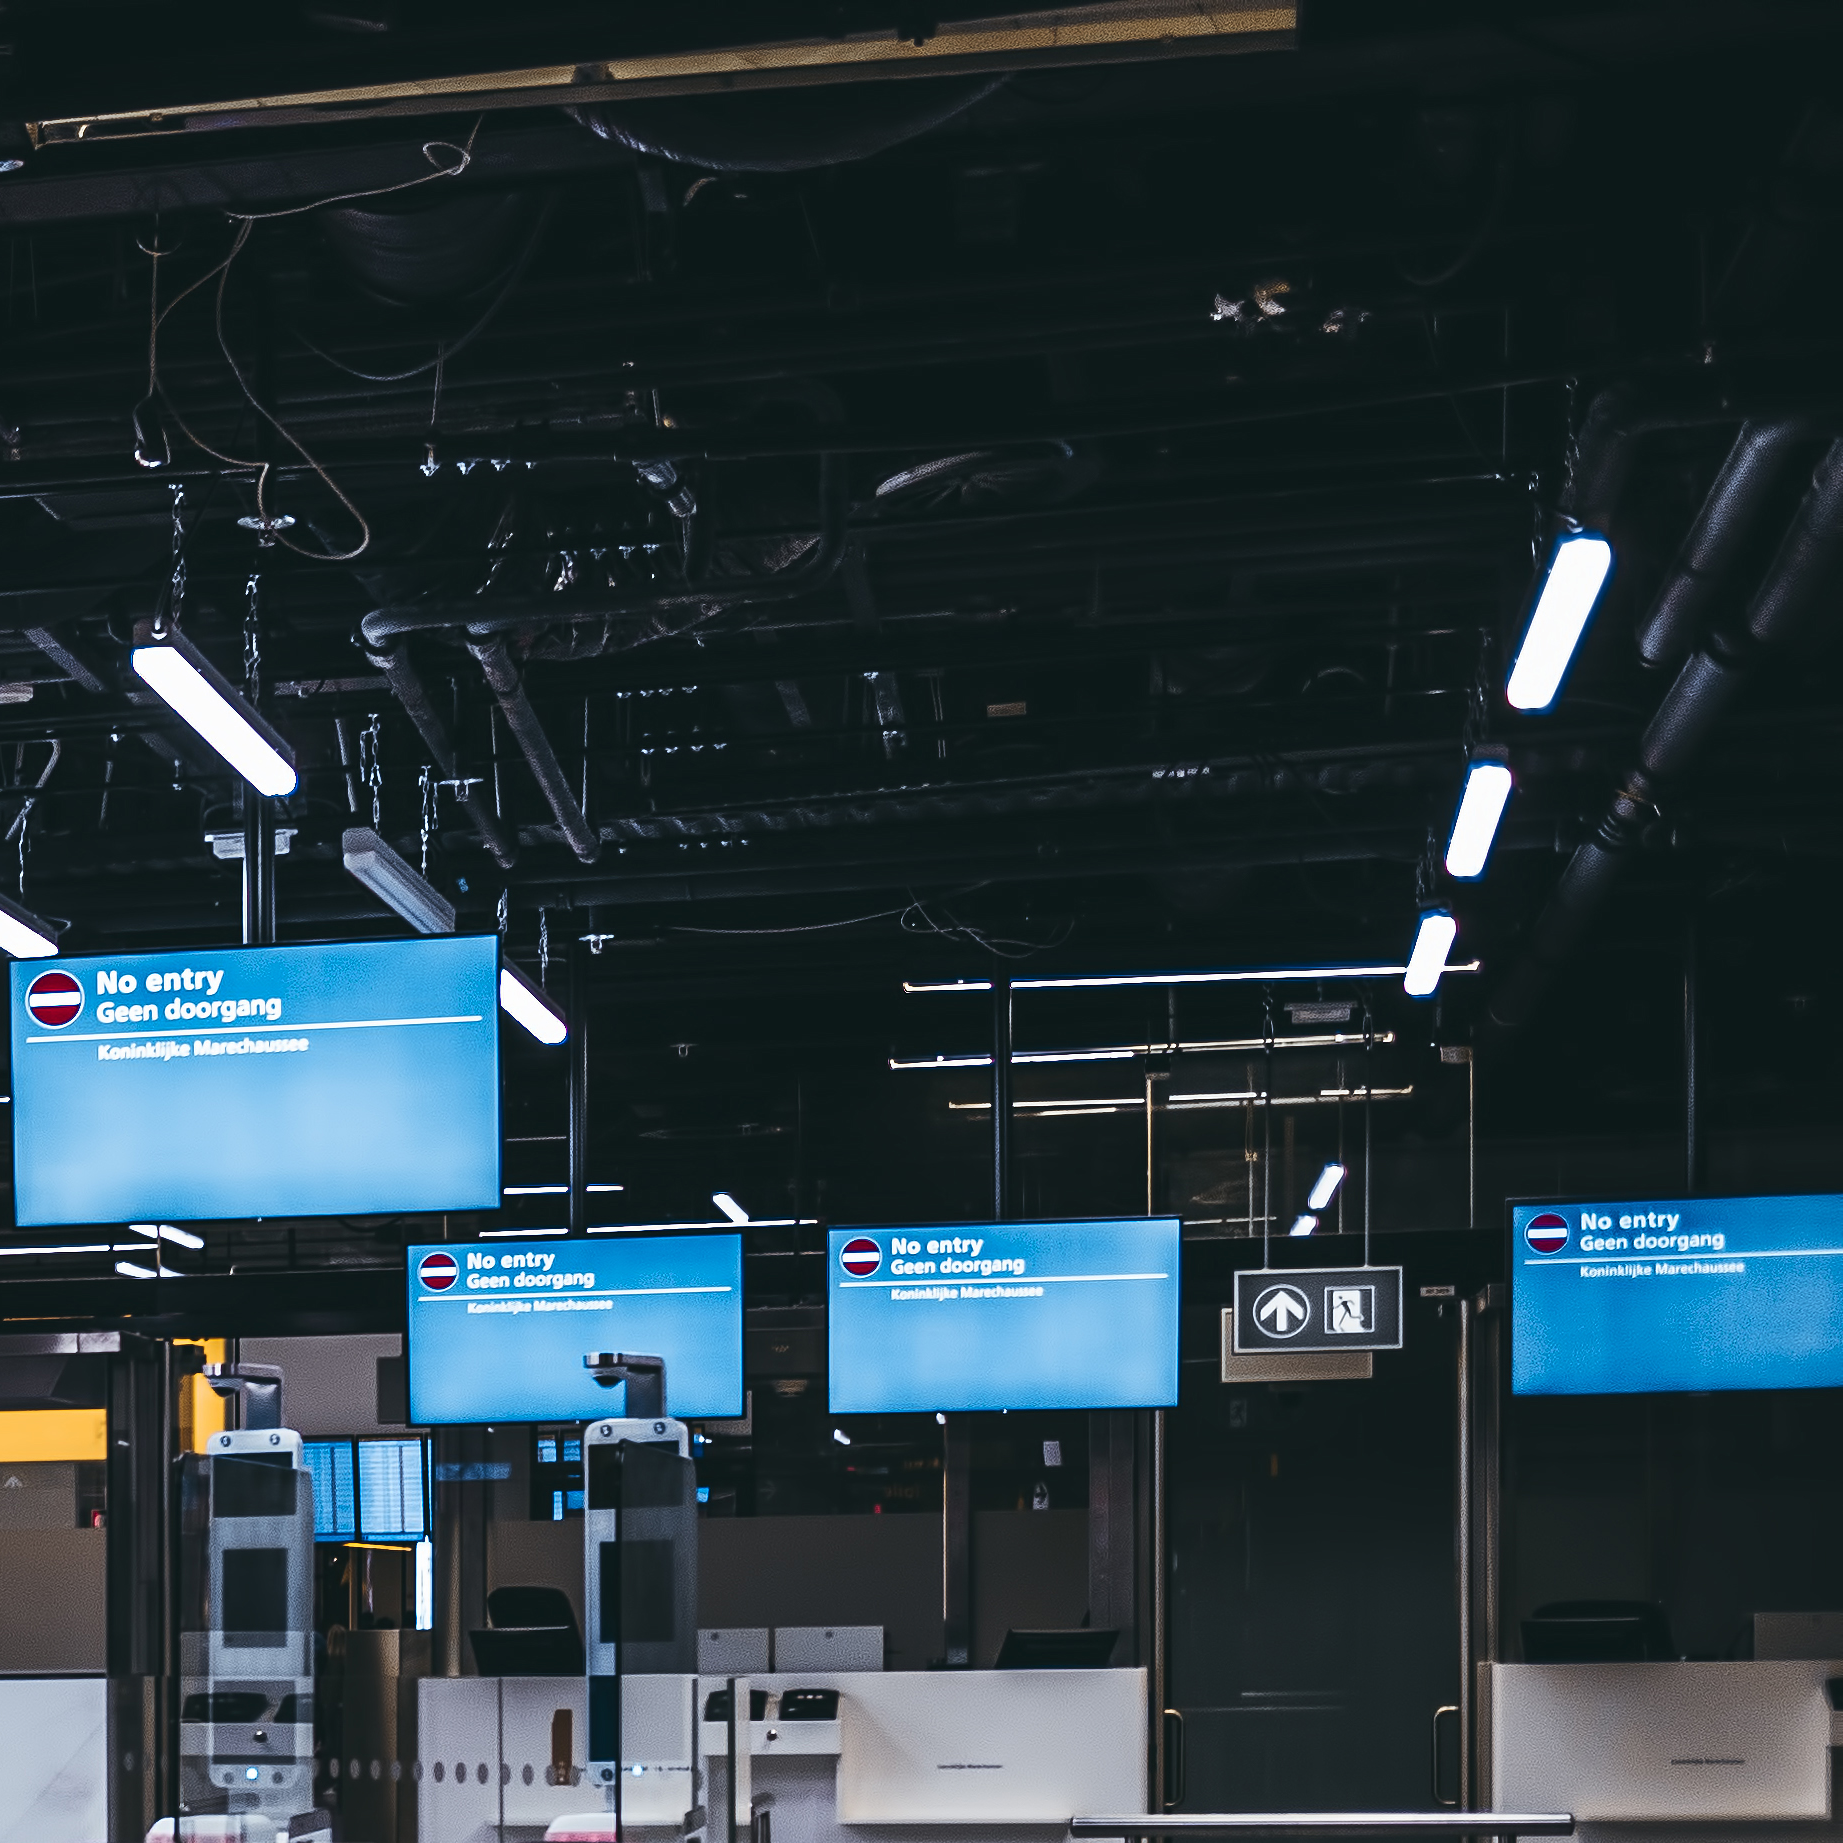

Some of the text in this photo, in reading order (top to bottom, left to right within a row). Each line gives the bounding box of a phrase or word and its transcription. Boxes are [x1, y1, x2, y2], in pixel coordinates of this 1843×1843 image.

[96, 967, 224, 996] No entry
[96, 995, 282, 1023] Geen doorgang
[97, 1036, 309, 1061] Koninklijke Marechaussee
[1580, 1211, 1680, 1231] No entry
[891, 1236, 984, 1257] No entry
[1580, 1232, 1726, 1251] Geen doorgang
[467, 1252, 556, 1272] No entry
[890, 1257, 1025, 1275] Geen doorgang
[466, 1271, 595, 1290] Geen doorgang
